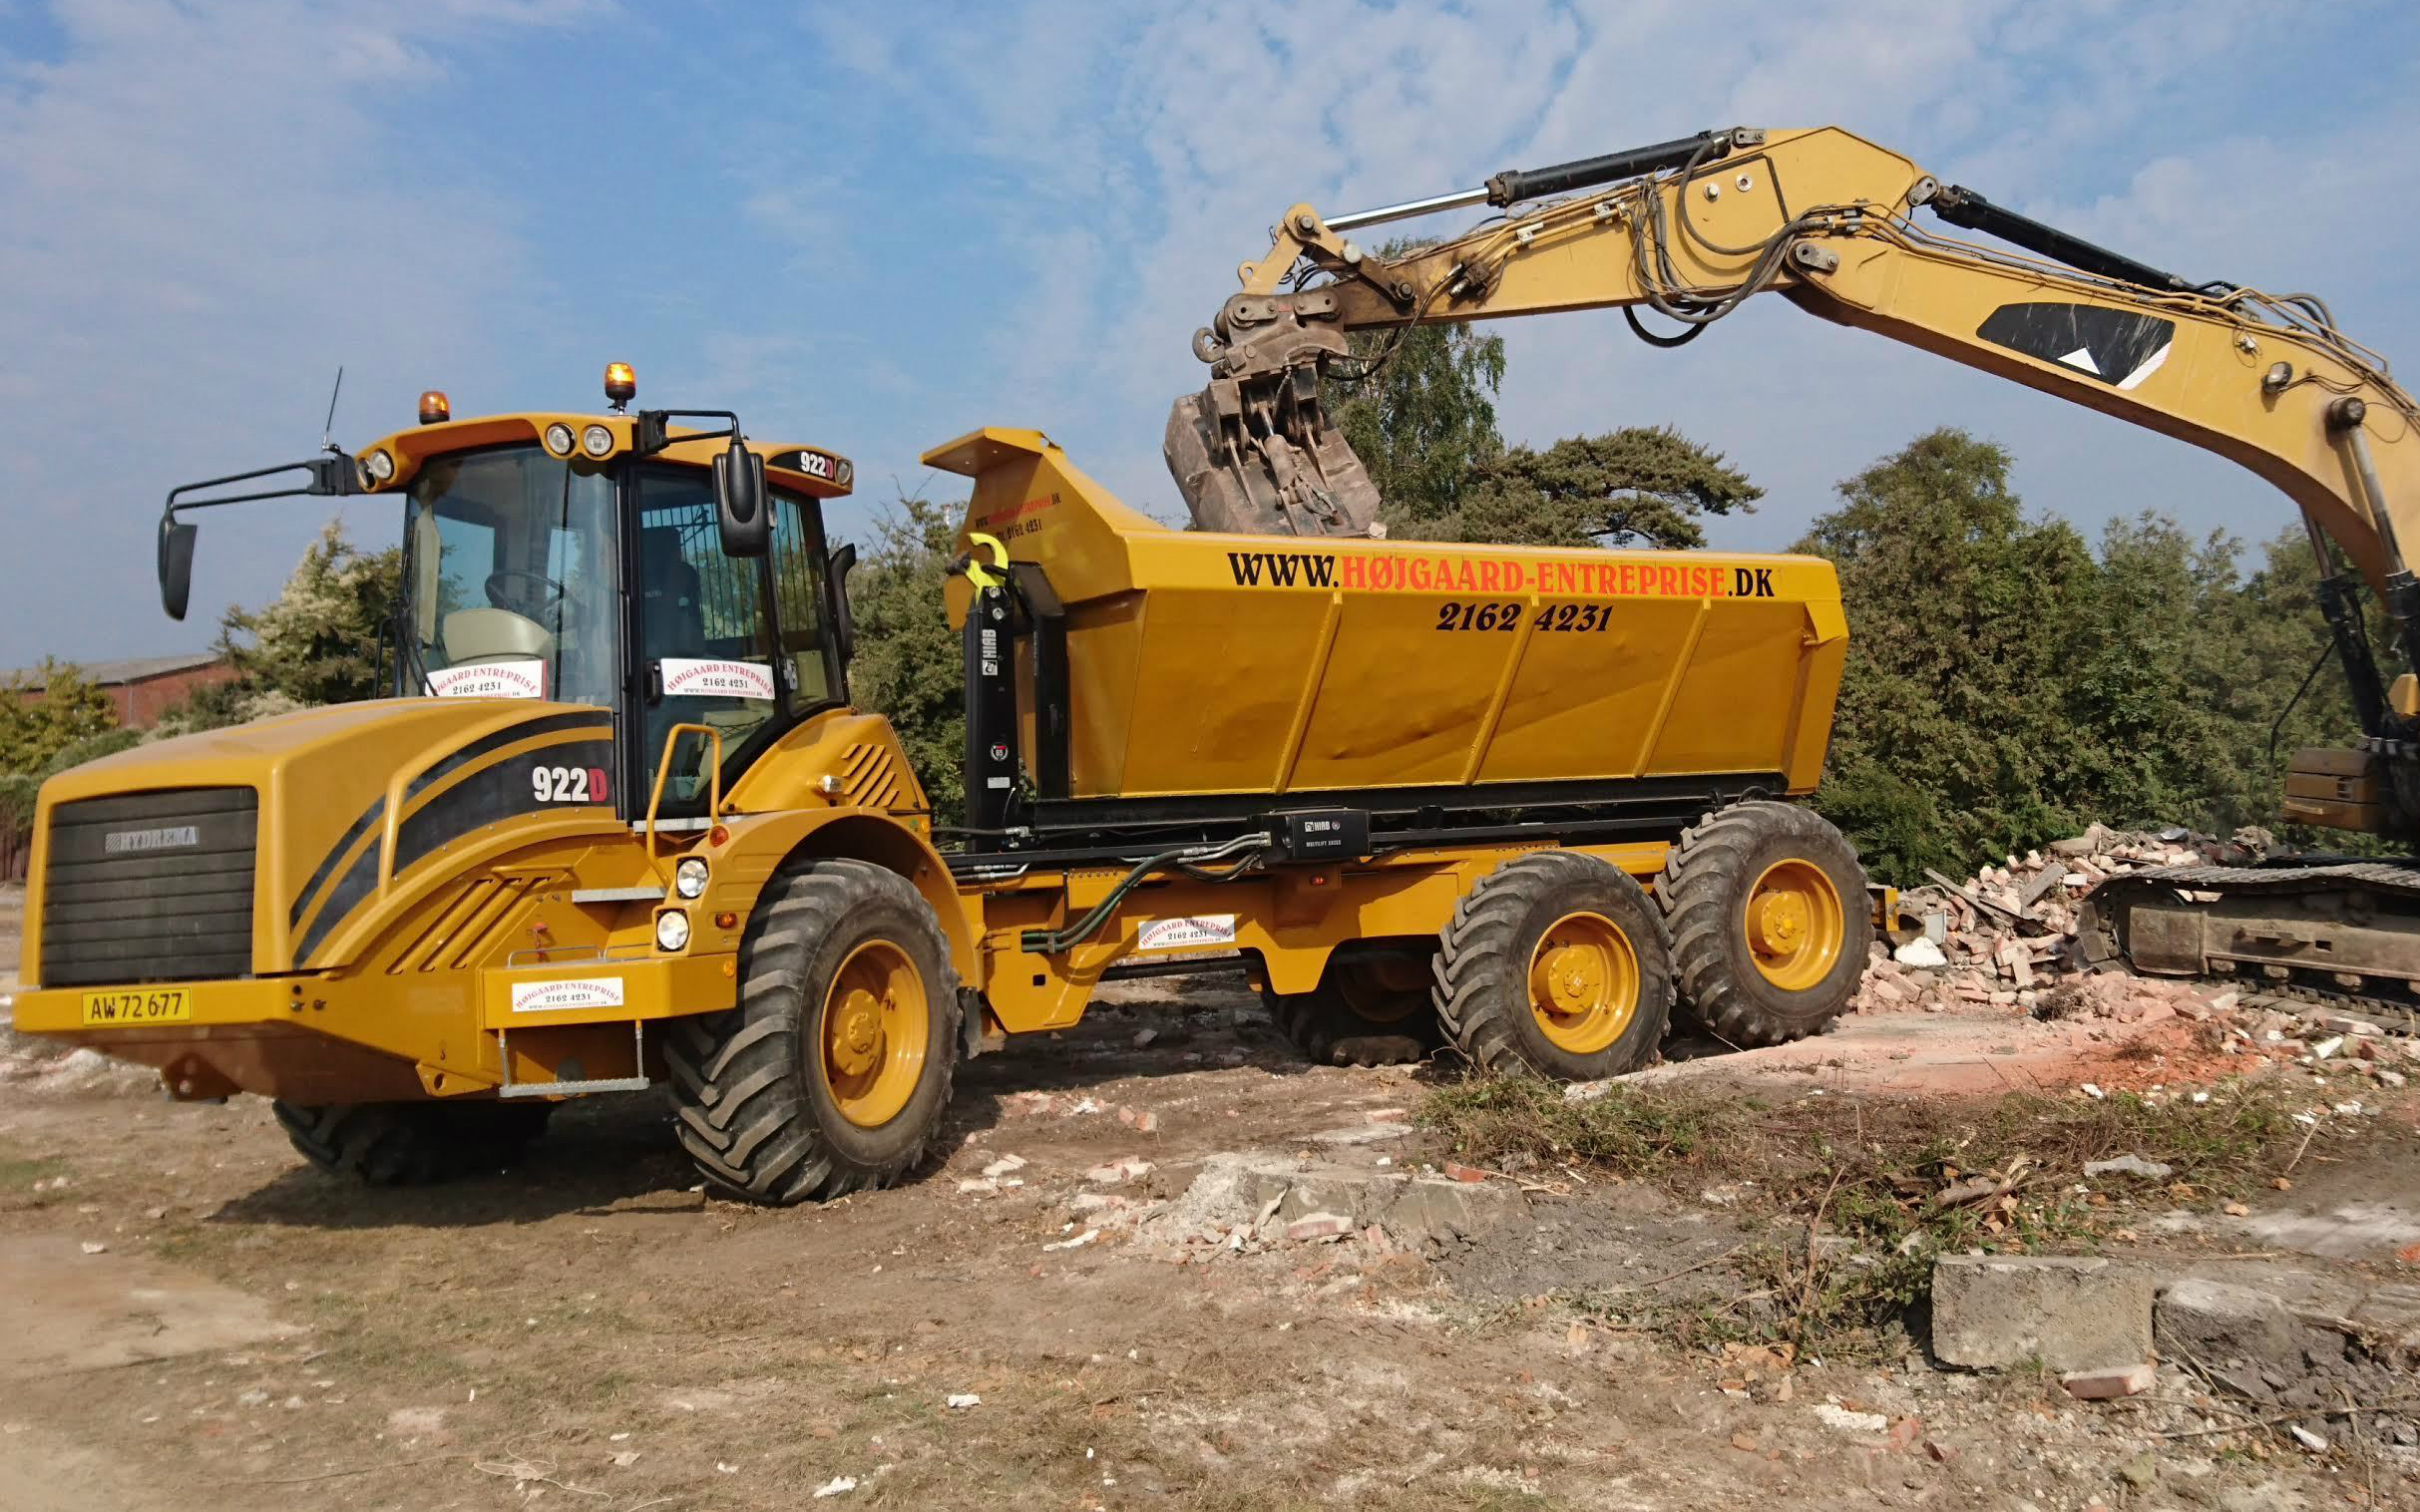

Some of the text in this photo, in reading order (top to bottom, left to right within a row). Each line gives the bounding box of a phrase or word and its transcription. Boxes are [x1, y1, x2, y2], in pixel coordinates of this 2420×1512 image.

[800, 451, 834, 479] 922D
[1007, 523, 1024, 540] 2162
[1025, 519, 1042, 534] 4231
[1227, 552, 1775, 598] WWW.HØJGAARD-ENTREPRISE.DK
[1435, 602, 1614, 633] 2162 4231
[982, 628, 998, 659] HIAB
[452, 683, 475, 695] 2162
[478, 681, 502, 692] 4231
[473, 666, 539, 695] ENTREPRISE
[702, 677, 749, 689] 2162 4231
[722, 663, 774, 697] ENTREPRISE
[532, 766, 607, 802] 922D
[120, 826, 198, 851] HYDREMA
[1314, 821, 1331, 832] HIAB
[1167, 930, 1208, 941] 2162 4231
[1184, 919, 1232, 939] ENTREPRISE
[545, 994, 569, 1003] 2162
[565, 982, 620, 1002] ENTREPRISE
[91, 992, 183, 1019] AW 72 677
